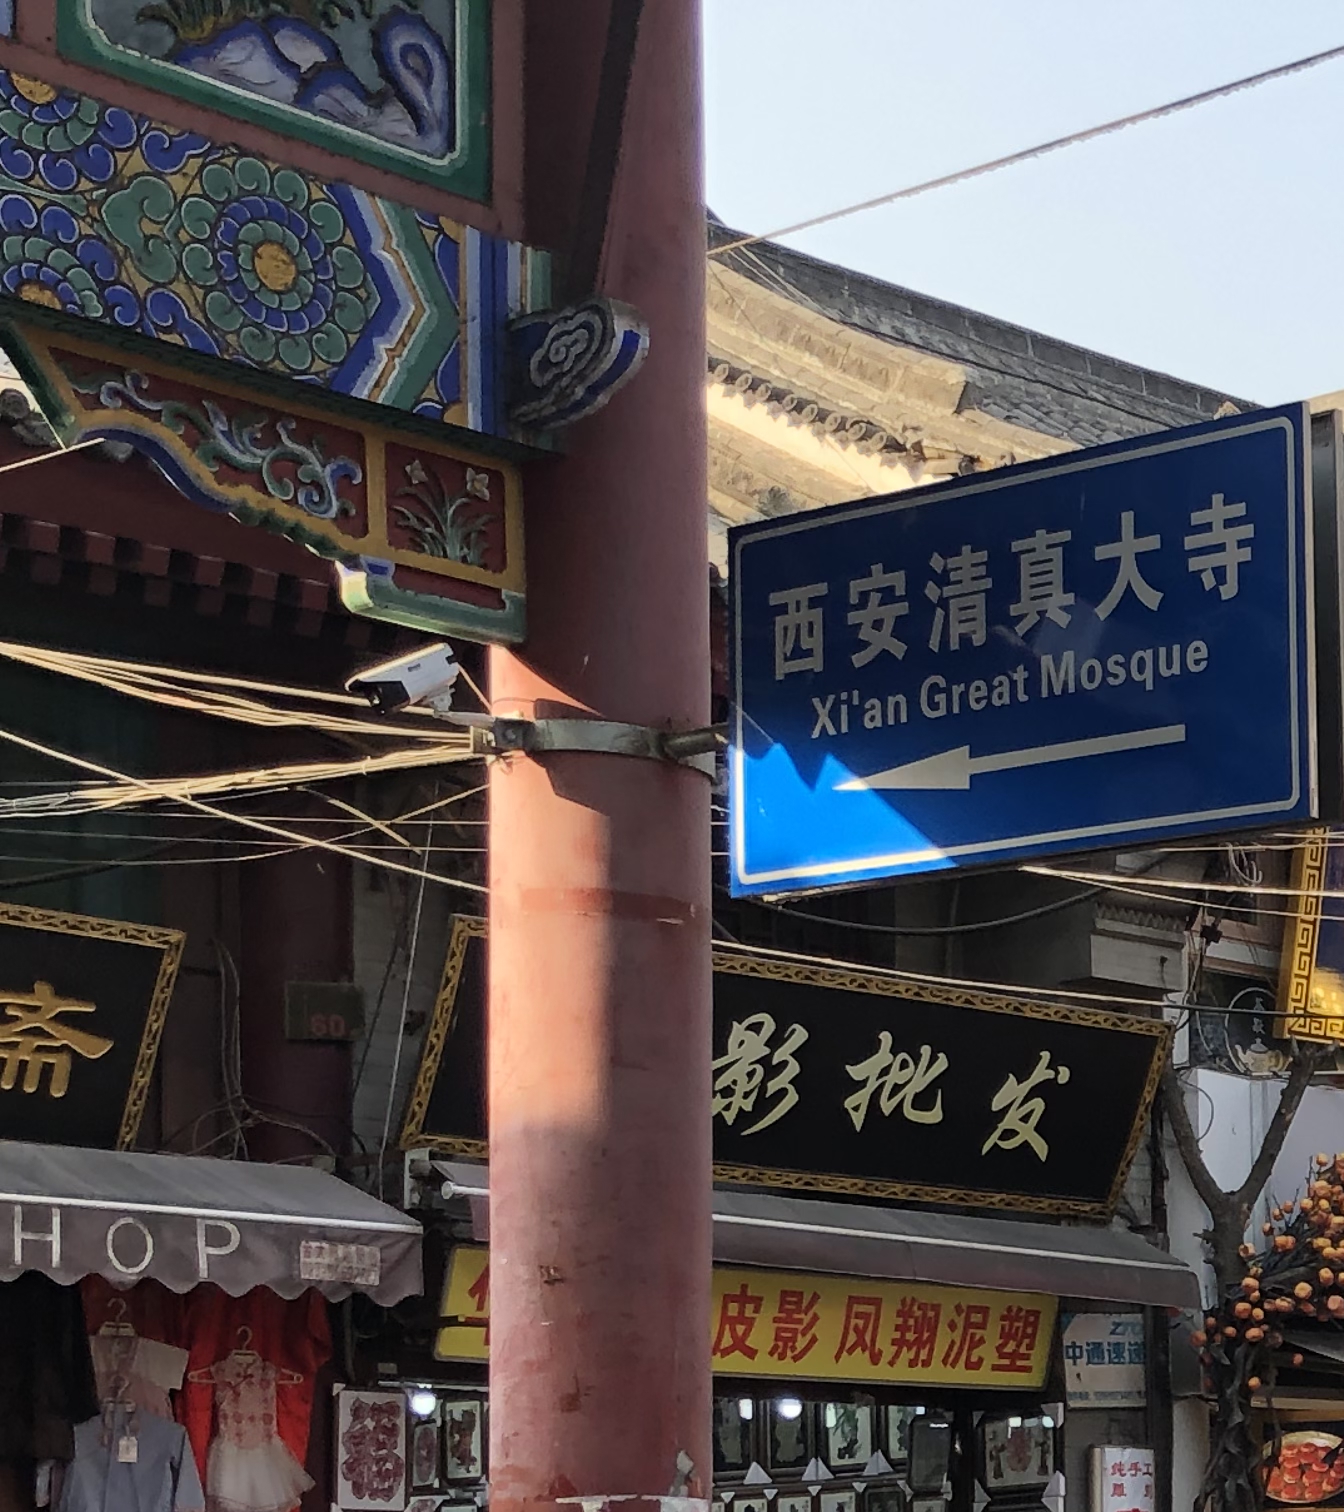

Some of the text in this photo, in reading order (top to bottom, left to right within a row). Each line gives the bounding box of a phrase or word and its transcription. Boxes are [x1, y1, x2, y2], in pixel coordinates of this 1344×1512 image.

[769, 494, 1254, 680] 西安清真大寺
[811, 639, 1208, 738] Xi'an Great Mosque
[711, 1011, 1071, 1162] 影批发
[712, 1283, 1042, 1374] 皮影 凤翔泥塑
